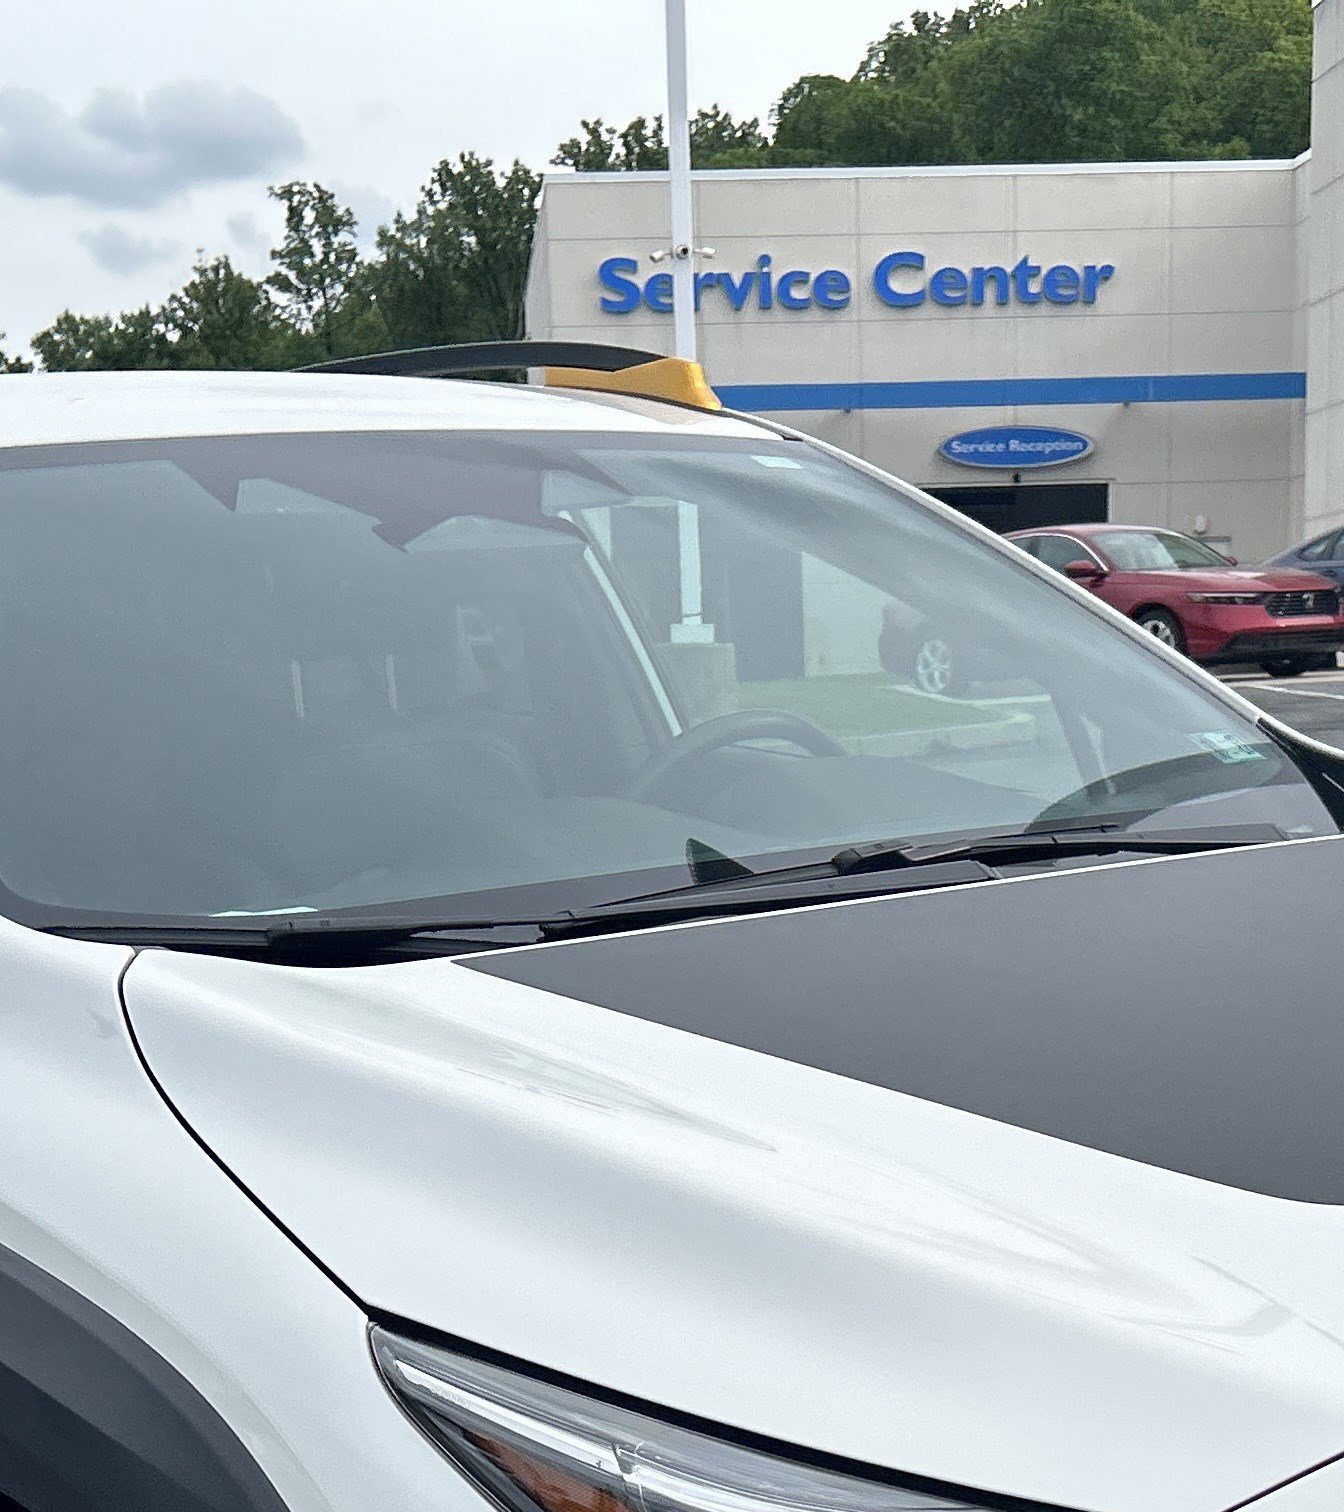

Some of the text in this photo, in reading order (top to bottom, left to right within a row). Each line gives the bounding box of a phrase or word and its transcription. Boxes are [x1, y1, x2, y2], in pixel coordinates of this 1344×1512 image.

[597, 250, 1116, 314] Service Center
[950, 440, 1006, 454] Service
